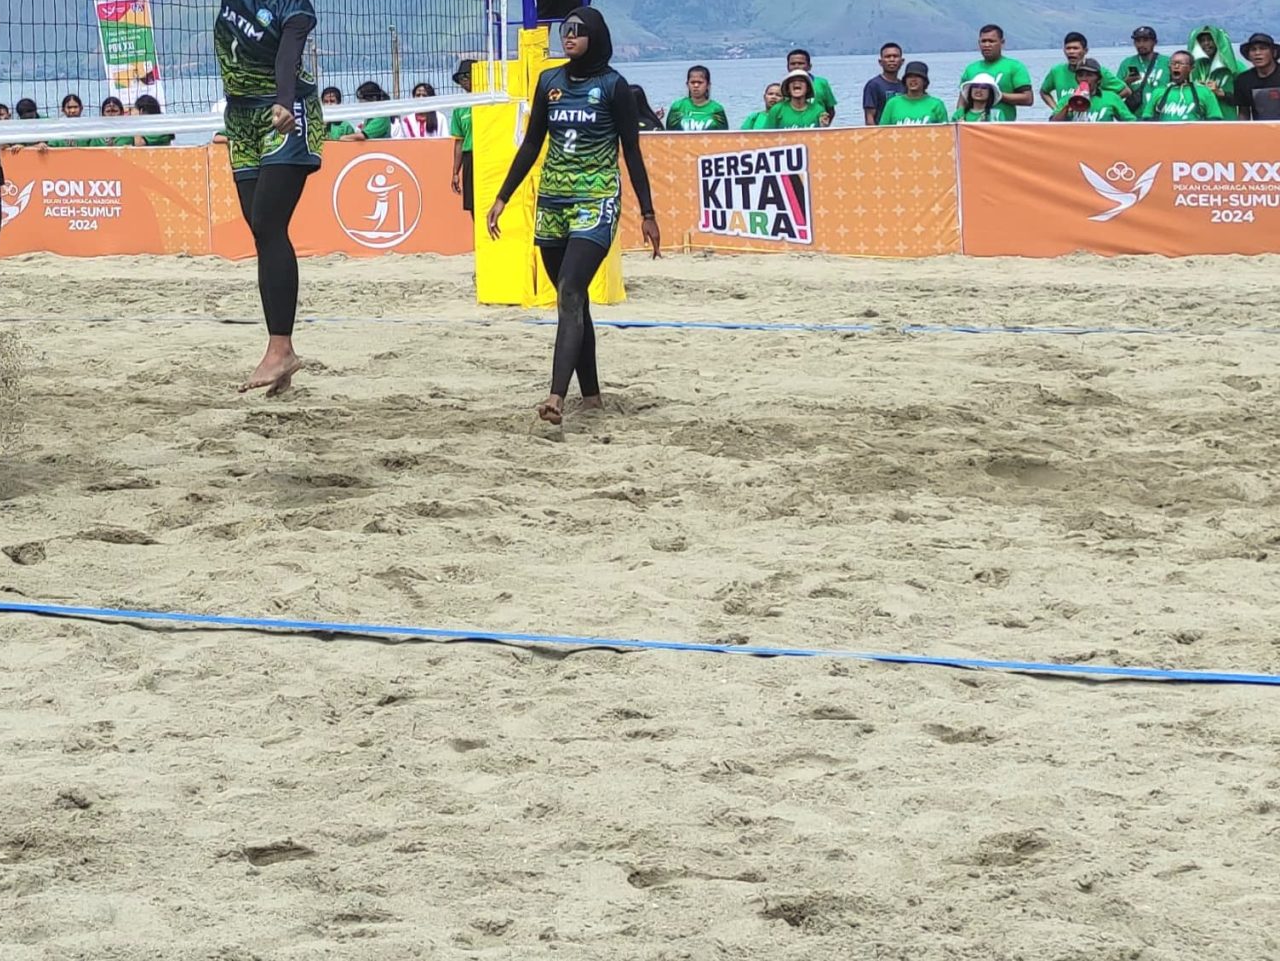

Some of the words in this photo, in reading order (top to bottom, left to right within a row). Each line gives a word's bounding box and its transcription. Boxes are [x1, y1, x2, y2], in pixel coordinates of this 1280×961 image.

[222, 6, 264, 41] JATIM
[549, 109, 596, 123] JATIM
[563, 128, 578, 153] 2
[700, 147, 803, 178] BERSATU
[1172, 162, 1235, 182] PON
[1242, 162, 1280, 182] XX
[41, 180, 84, 197] PON
[88, 180, 122, 197] XXI
[702, 175, 787, 211] KITA
[1174, 193, 1280, 207] ACEH-SUMU
[44, 206, 122, 217] ACEH-SUMUT
[1210, 209, 1255, 223] 2024
[68, 219, 98, 231] 2024
